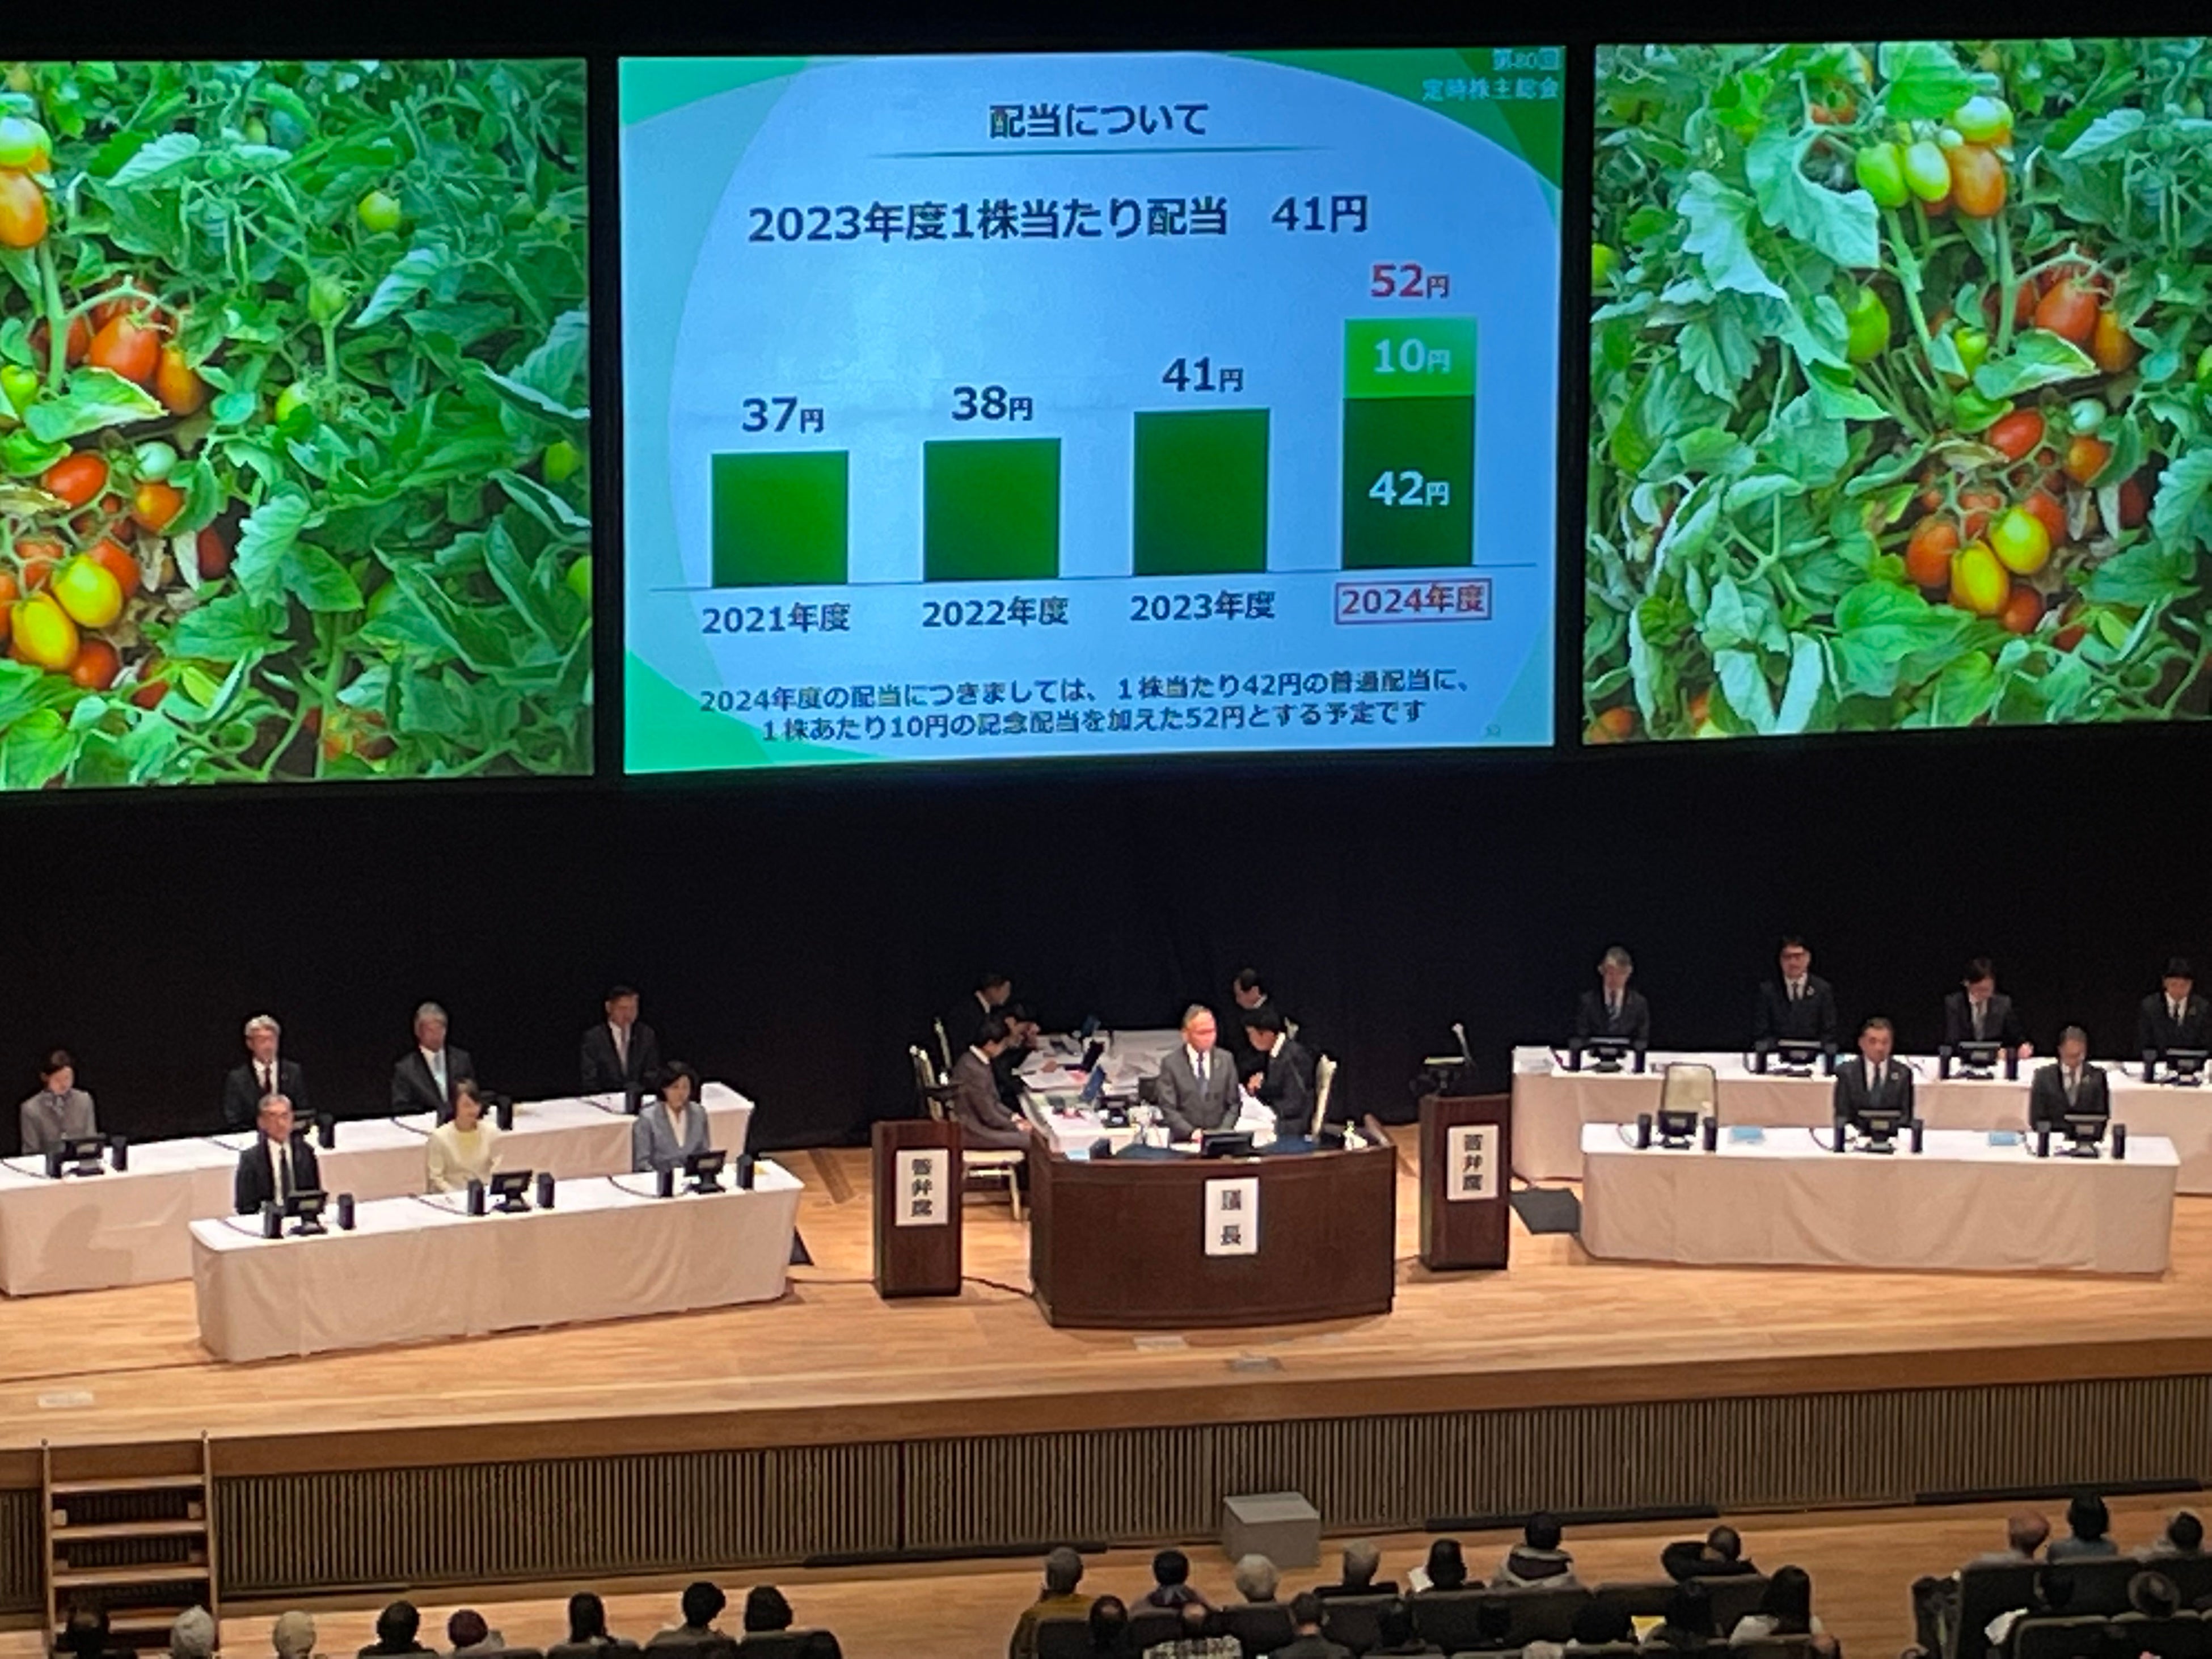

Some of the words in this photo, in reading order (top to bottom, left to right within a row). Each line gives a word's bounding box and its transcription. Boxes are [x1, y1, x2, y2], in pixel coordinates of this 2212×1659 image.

[990, 102, 1209, 138] 配当について
[748, 196, 1228, 243] 2023年度1株当たり配当
[1271, 194, 1368, 233] 41円
[1370, 263, 1450, 299] 52円
[1375, 340, 1451, 373] 10円
[1162, 357, 1243, 392] 41円
[742, 396, 824, 432] 37円
[952, 386, 1033, 422] 38円
[1369, 470, 1450, 506] 42円
[922, 596, 1070, 628] 2022年度
[1130, 590, 1276, 621] 2023年度
[1342, 583, 1485, 615] 2024年度
[702, 602, 851, 634] 2021年度
